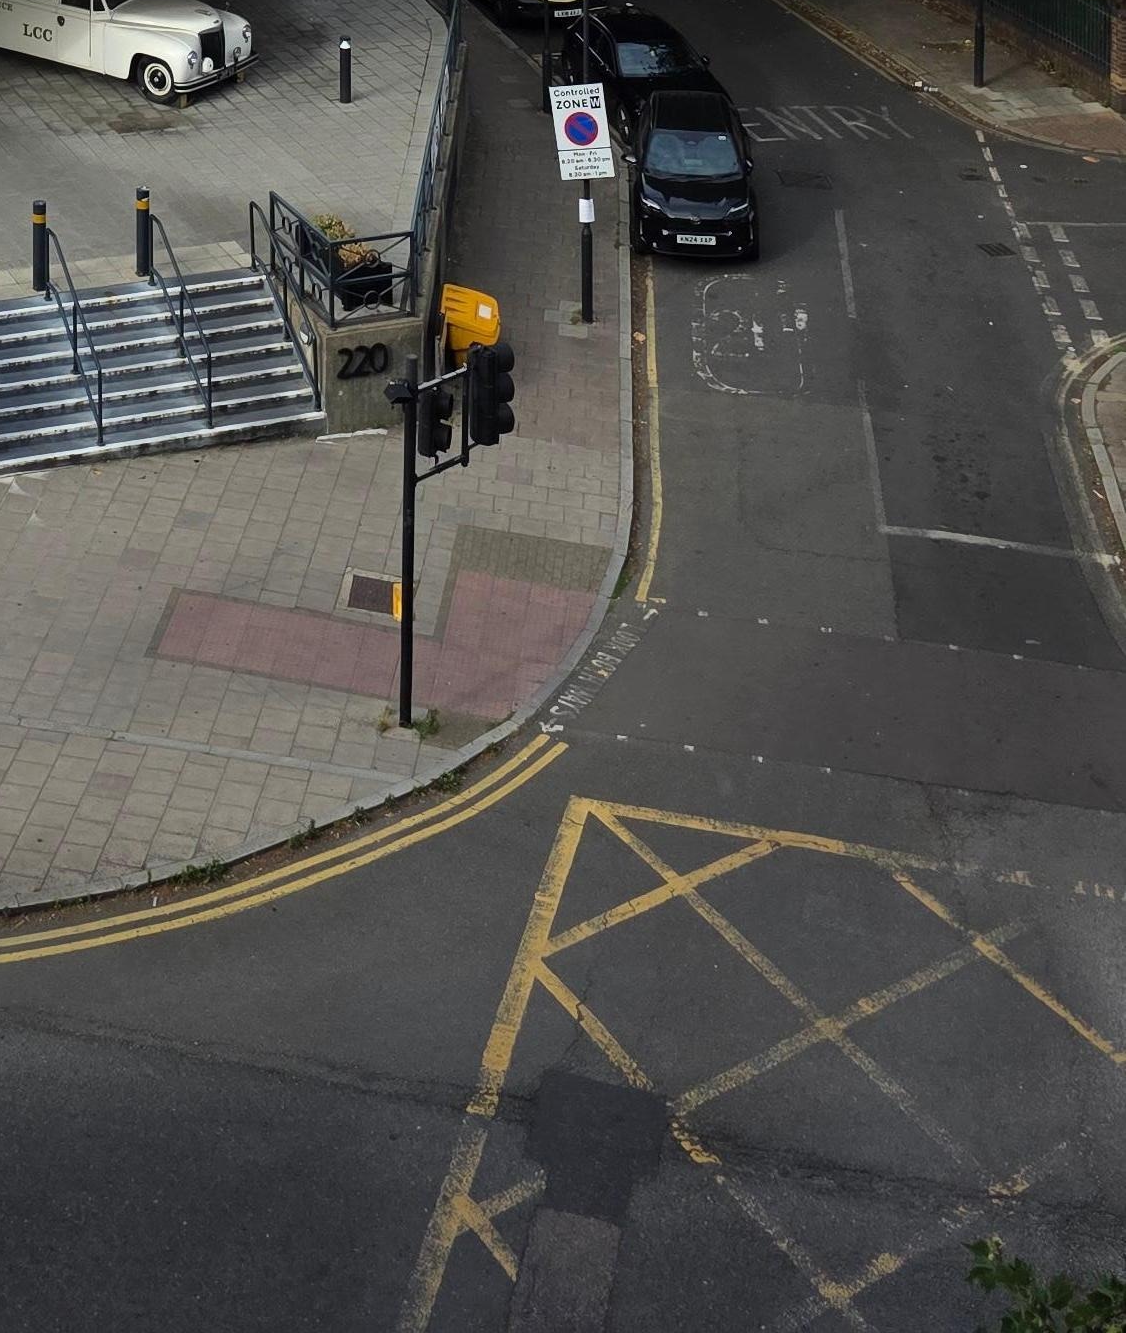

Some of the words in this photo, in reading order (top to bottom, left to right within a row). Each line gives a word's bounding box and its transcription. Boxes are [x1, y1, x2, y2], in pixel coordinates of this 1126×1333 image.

[22, 23, 53, 42] LCC
[554, 87, 600, 97] Controlled
[556, 99, 589, 110] ZONE
[590, 96, 601, 109] W
[737, 105, 915, 142] ENTRY
[337, 342, 389, 380] 220
